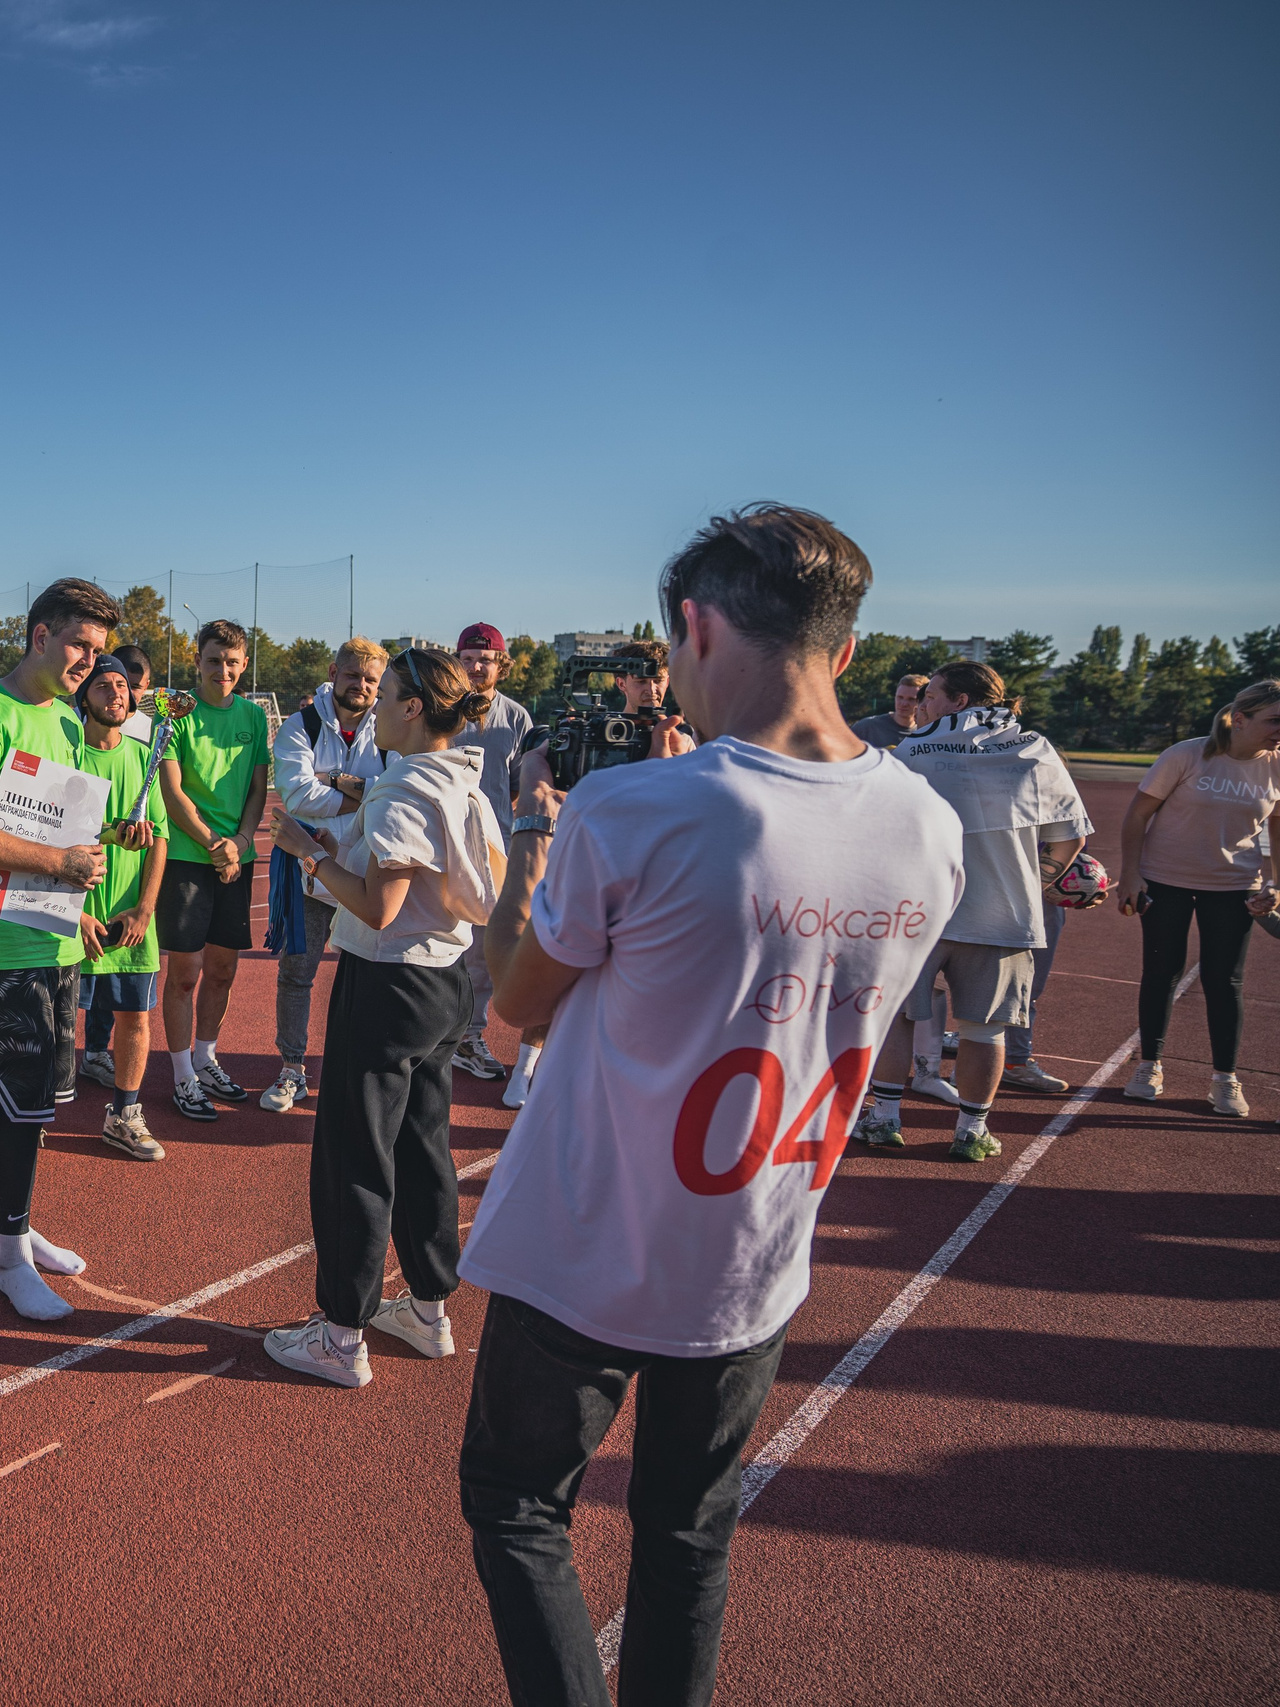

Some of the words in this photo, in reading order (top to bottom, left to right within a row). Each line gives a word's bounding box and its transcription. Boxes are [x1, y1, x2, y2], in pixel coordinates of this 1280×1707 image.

[909, 743, 966, 757] ЗАВТРАКИ
[1196, 776, 1271, 799] SUNNY
[0, 790, 65, 818] ДИПЛОМ
[15, 823, 48, 841] Bazilio
[37, 814, 62, 829] КОМАНДА
[751, 893, 927, 939] Wokcafé
[673, 1044, 873, 1197] 04
